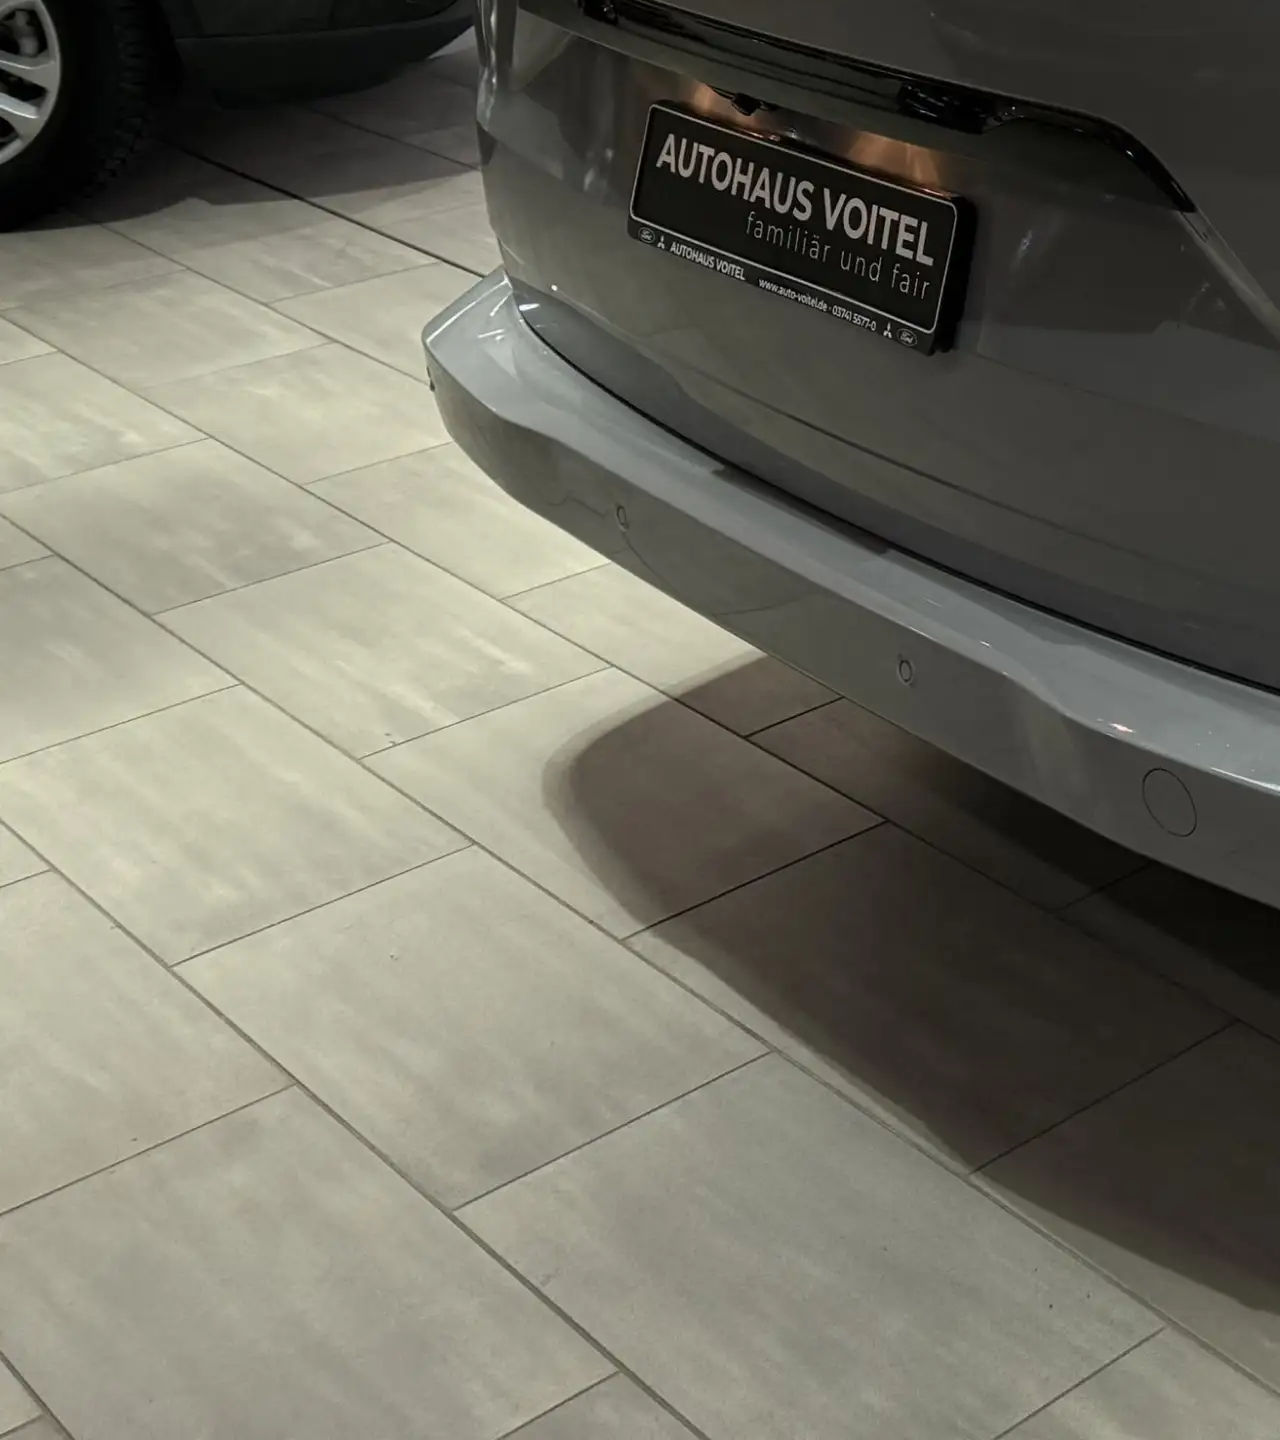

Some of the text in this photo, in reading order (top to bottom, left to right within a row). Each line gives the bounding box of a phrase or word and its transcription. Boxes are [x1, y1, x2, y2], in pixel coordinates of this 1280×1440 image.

[656, 133, 935, 267] AUTOHAUS VOITEL
[670, 241, 746, 281] AUTOHAUS VOITEL
[746, 210, 930, 299] familiär und fair
[758, 278, 828, 312] www.auto-voitel.de
